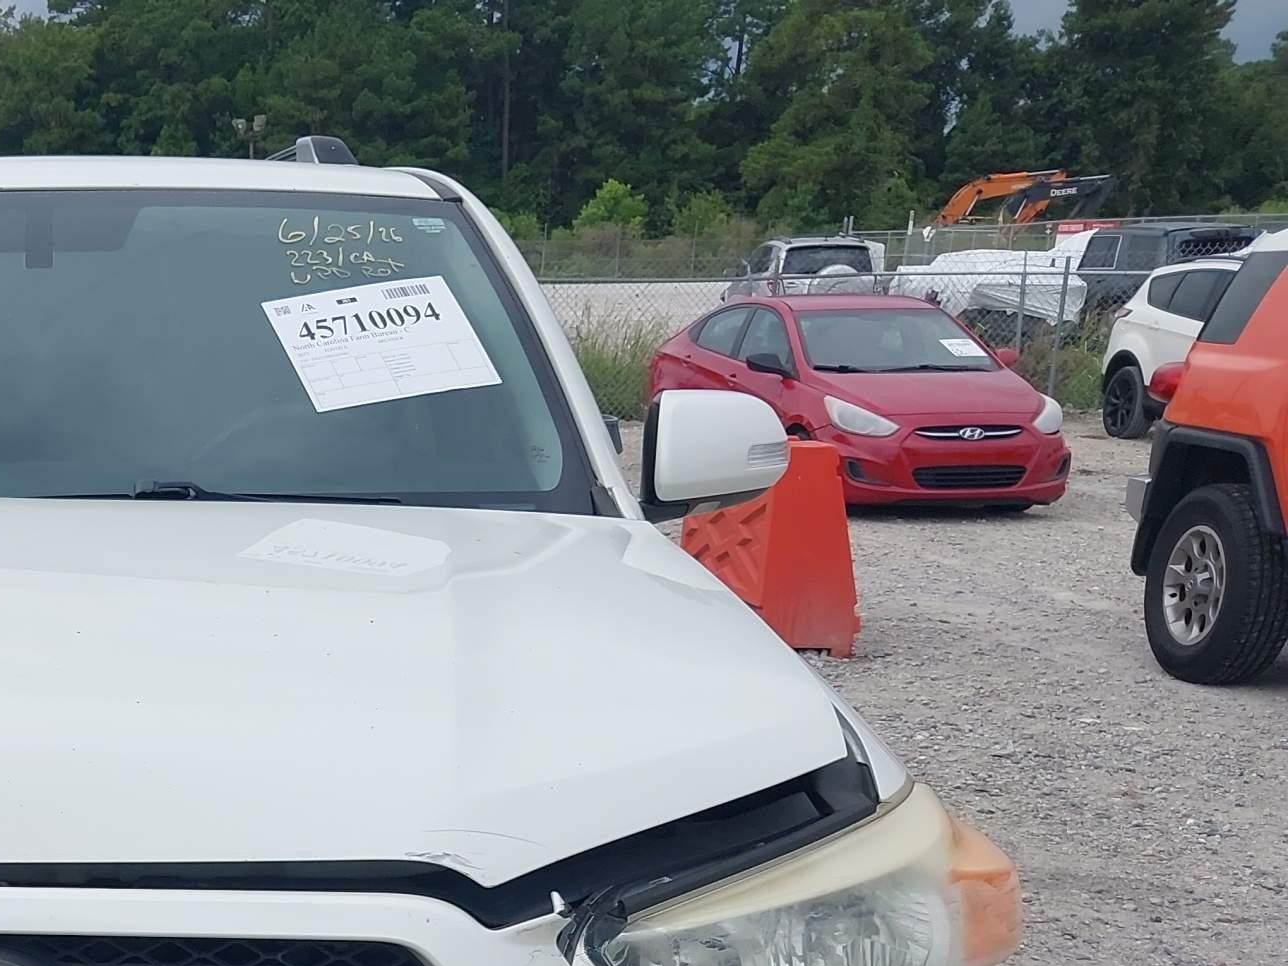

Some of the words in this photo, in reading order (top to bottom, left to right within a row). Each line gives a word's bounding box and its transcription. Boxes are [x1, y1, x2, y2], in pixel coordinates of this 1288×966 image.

[1050, 187, 1078, 197] DEERE
[278, 216, 403, 245] 6/25/26
[299, 302, 440, 340] 45710094
